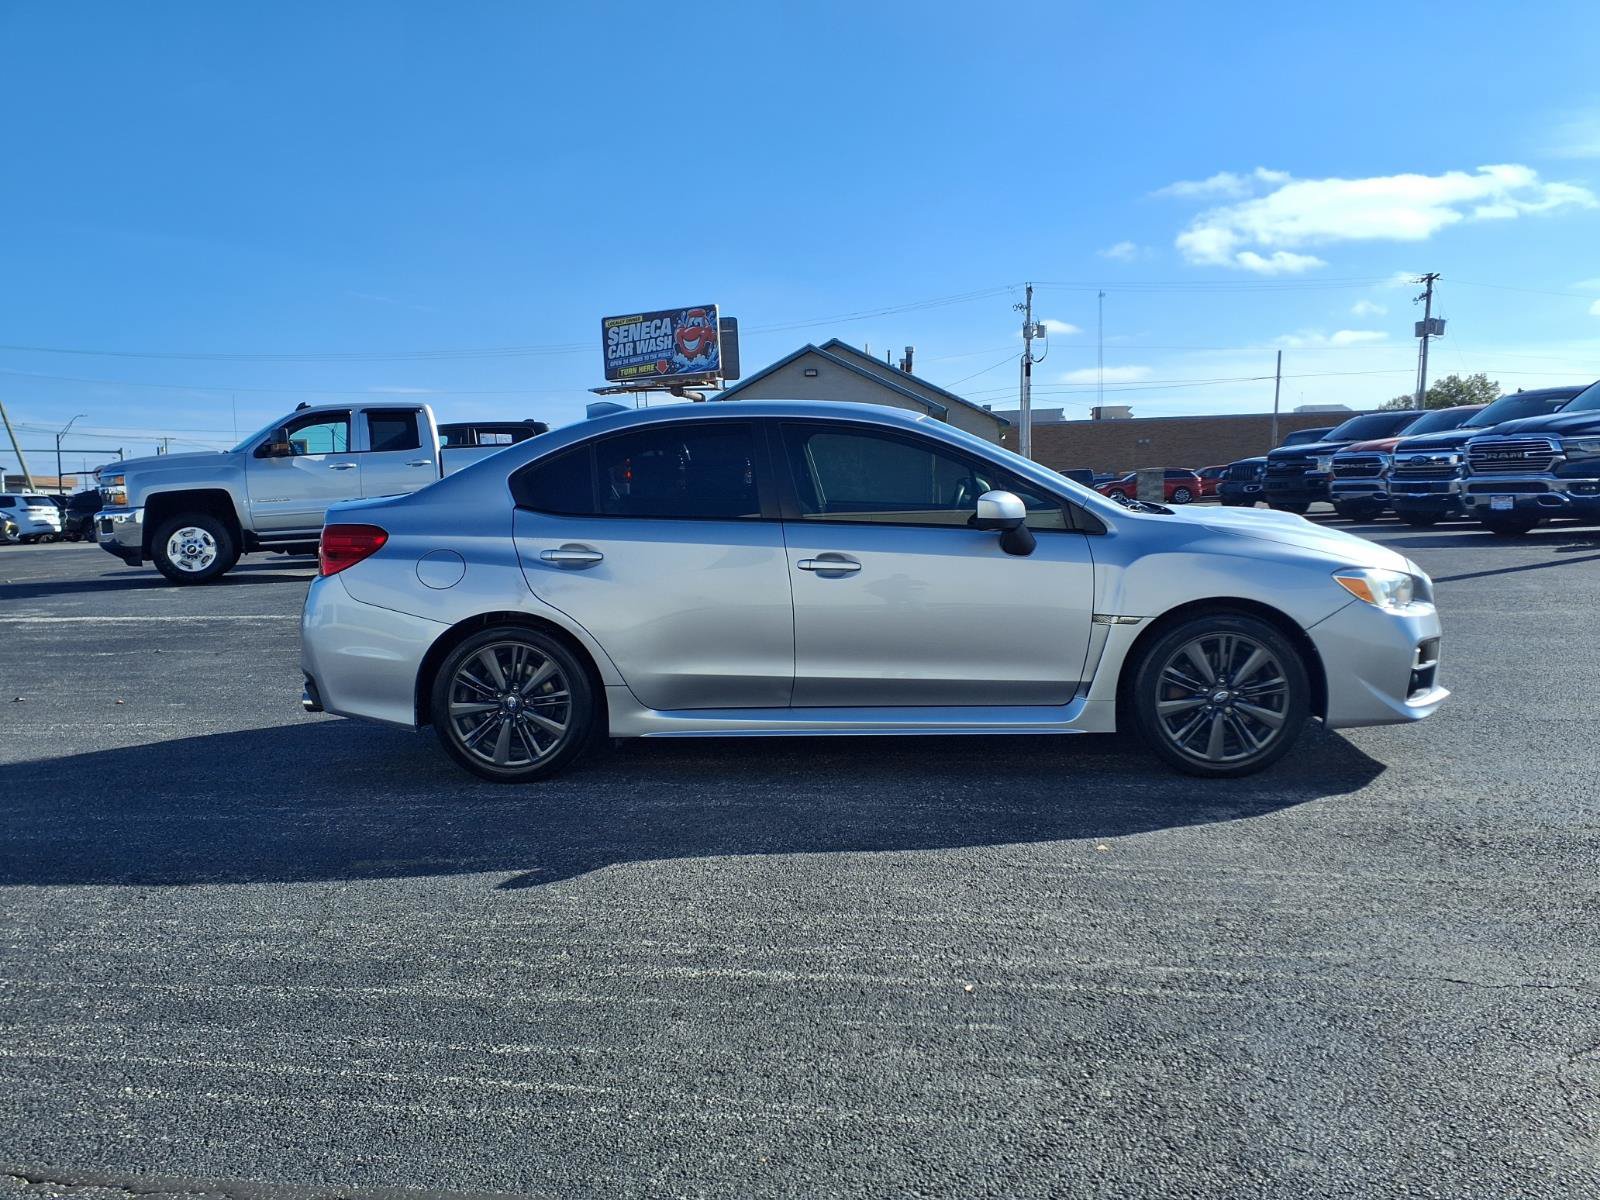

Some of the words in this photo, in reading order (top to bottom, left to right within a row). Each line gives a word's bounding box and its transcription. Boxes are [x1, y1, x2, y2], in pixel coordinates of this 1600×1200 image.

[608, 317, 672, 345] SENECA
[608, 342, 634, 359] CAR
[636, 335, 672, 354] WASH
[610, 359, 622, 367] OPEN
[620, 366, 637, 376] TURN
[639, 364, 655, 373] HERE
